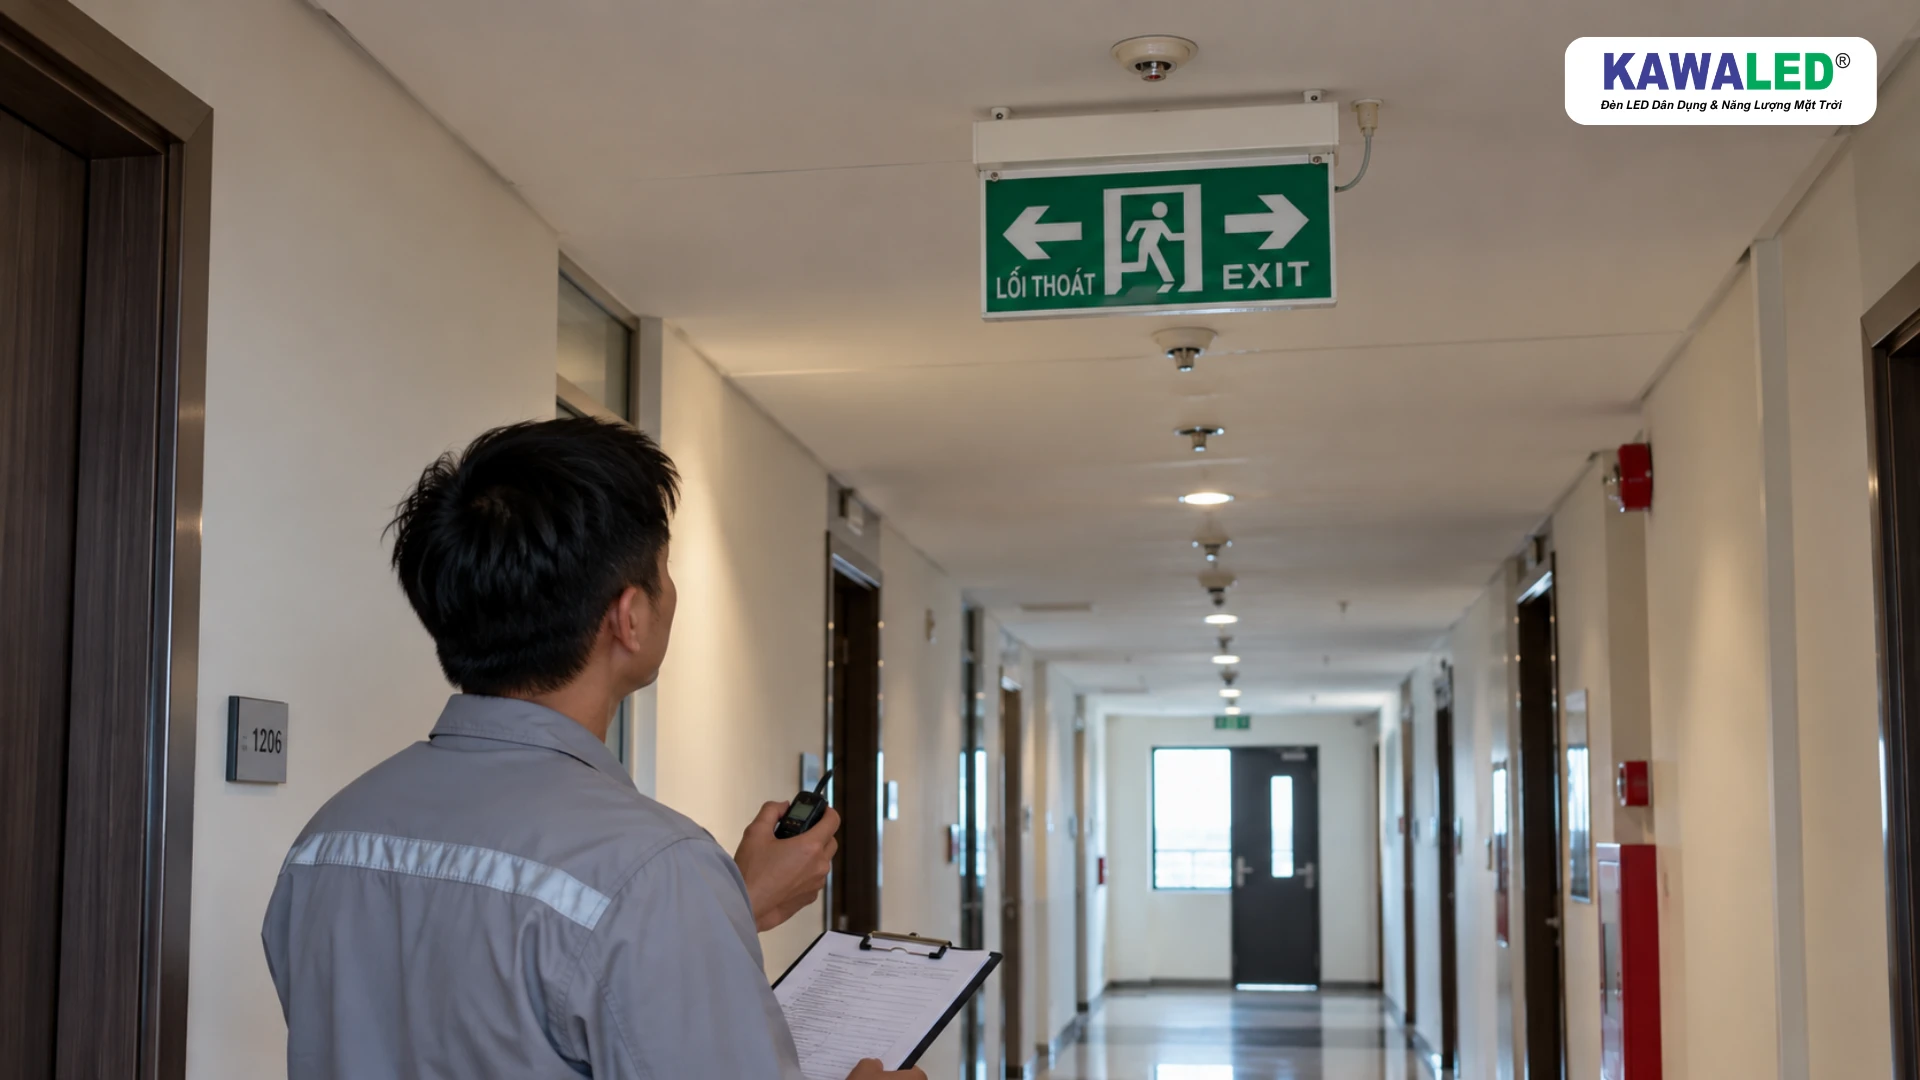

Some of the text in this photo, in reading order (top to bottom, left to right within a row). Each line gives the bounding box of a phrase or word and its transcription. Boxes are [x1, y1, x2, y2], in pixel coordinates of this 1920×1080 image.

[996, 266, 1096, 300] LỐI THOÁT
[1222, 261, 1310, 290] EXIT
[252, 727, 283, 754] 1206
